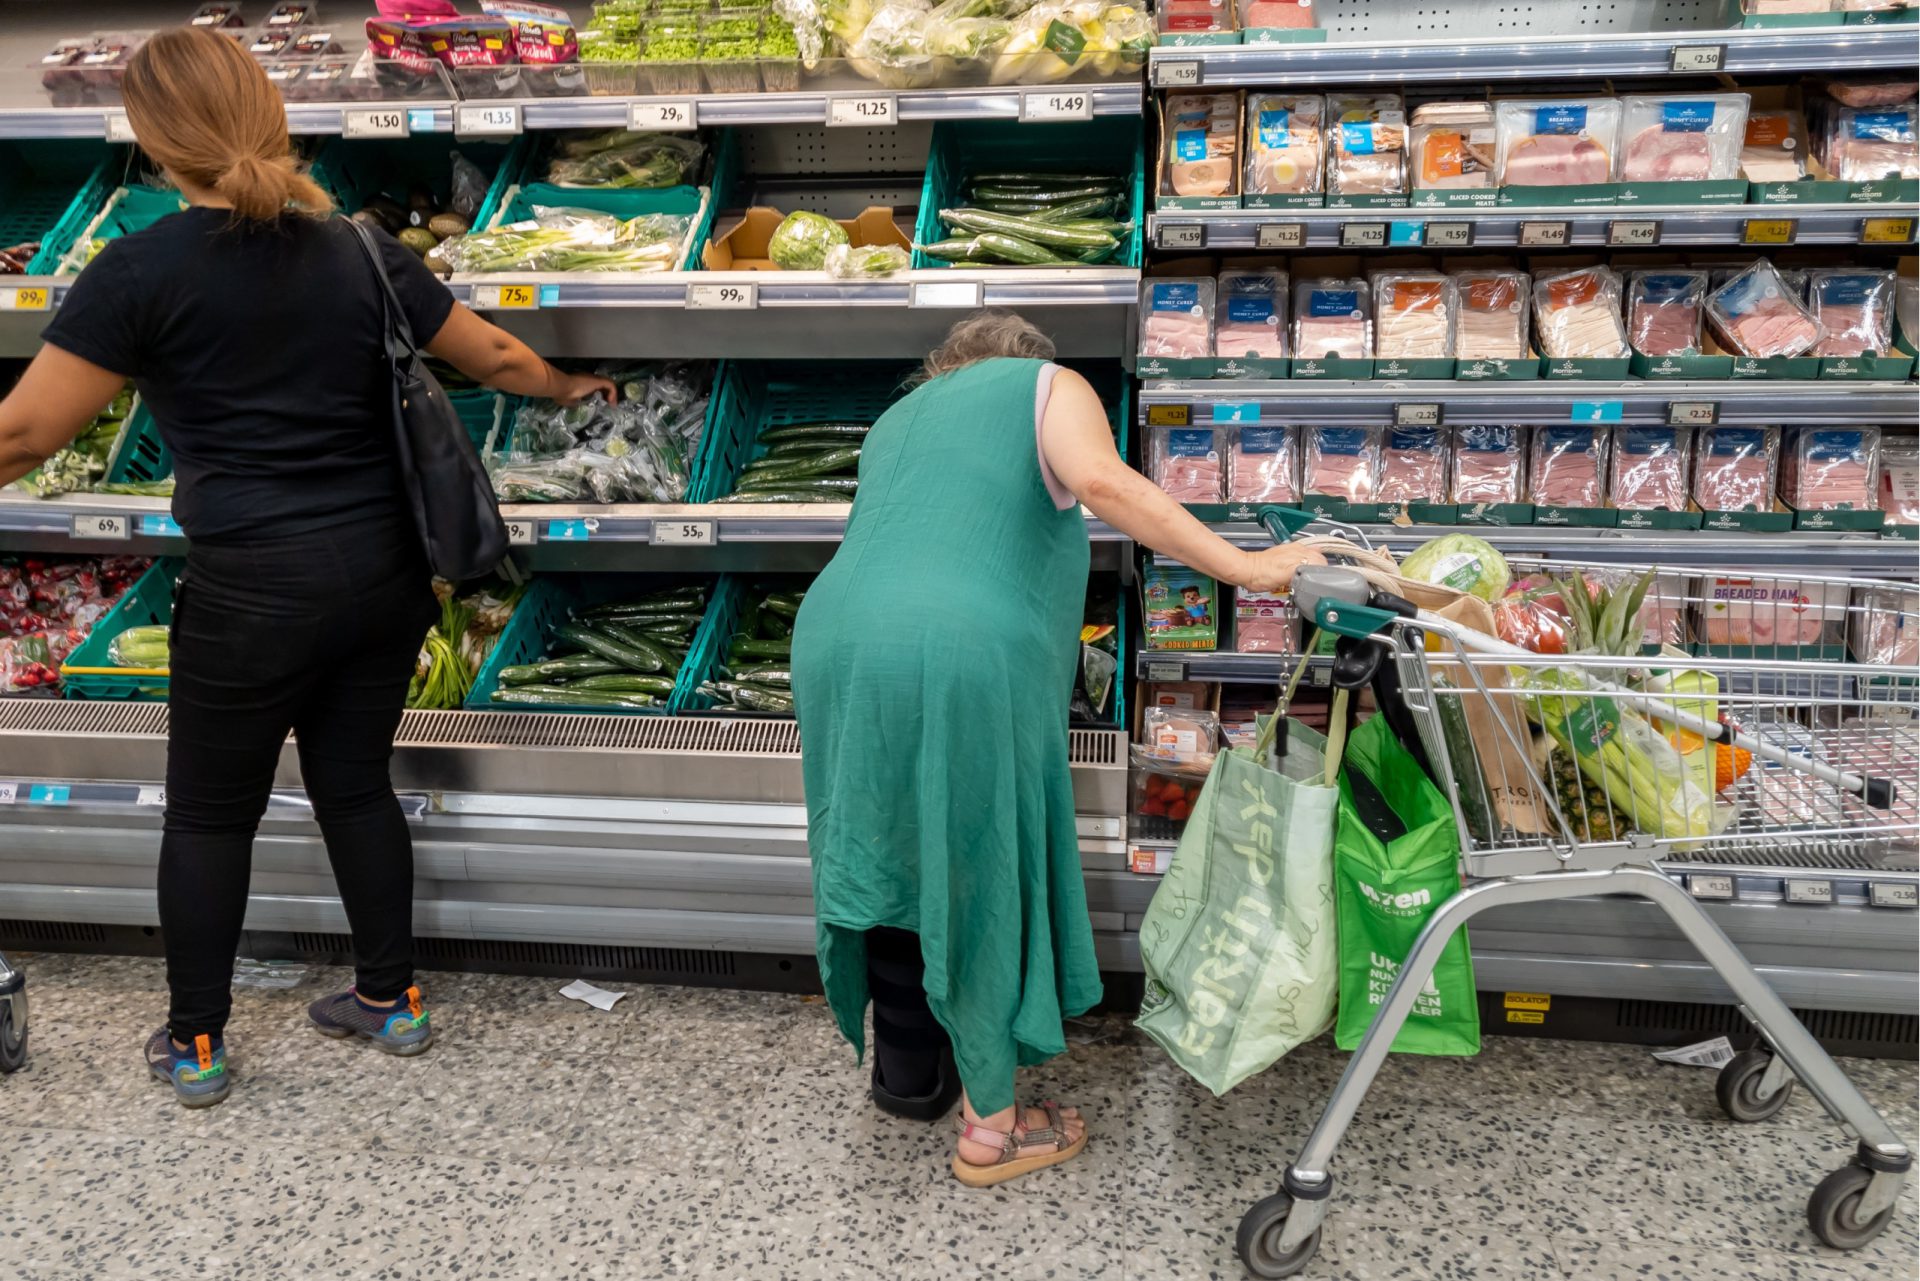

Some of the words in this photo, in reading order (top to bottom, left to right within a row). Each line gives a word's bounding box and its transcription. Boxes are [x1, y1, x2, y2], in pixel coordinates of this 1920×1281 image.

[1694, 54, 1718, 64] £2.50
[1176, 69, 1197, 79] £1.59
[1049, 96, 1084, 111] £1.49
[660, 107, 683, 121] 29p
[856, 102, 888, 116] £1.25
[369, 115, 400, 128] £1.50
[483, 111, 513, 125] £1.35
[1851, 191, 1882, 199] Morrisons
[1278, 231, 1299, 241] £1.25
[1362, 230, 1383, 240] £1.25
[1445, 230, 1467, 239] £1.59
[1541, 230, 1563, 239] £1.49
[1631, 229, 1653, 238] £1.49
[1767, 226, 1789, 236] £1.25
[1179, 232, 1200, 241] £1.59
[20, 291, 43, 305] 99p
[505, 288, 529, 303] 75p
[720, 288, 744, 303] 99p
[1651, 366, 1682, 374] Morrisons
[1734, 366, 1767, 374] Morrisons
[1825, 366, 1858, 374] Morrisons
[1167, 411, 1185, 419] £1.25
[1415, 411, 1437, 419] £2.25
[1689, 410, 1713, 419] £2.25
[98, 519, 120, 533] 69p
[682, 525, 704, 539] 55p
[1714, 588, 1768, 600] BREADED
[1772, 589, 1798, 600] HAM
[1163, 640, 1191, 649] COOKED
[1192, 640, 1215, 649] MEATS
[1709, 882, 1731, 892] £1.25
[1807, 887, 1831, 896] £2.50
[1358, 880, 1431, 909] wren
[1893, 890, 1916, 900] £2.50
